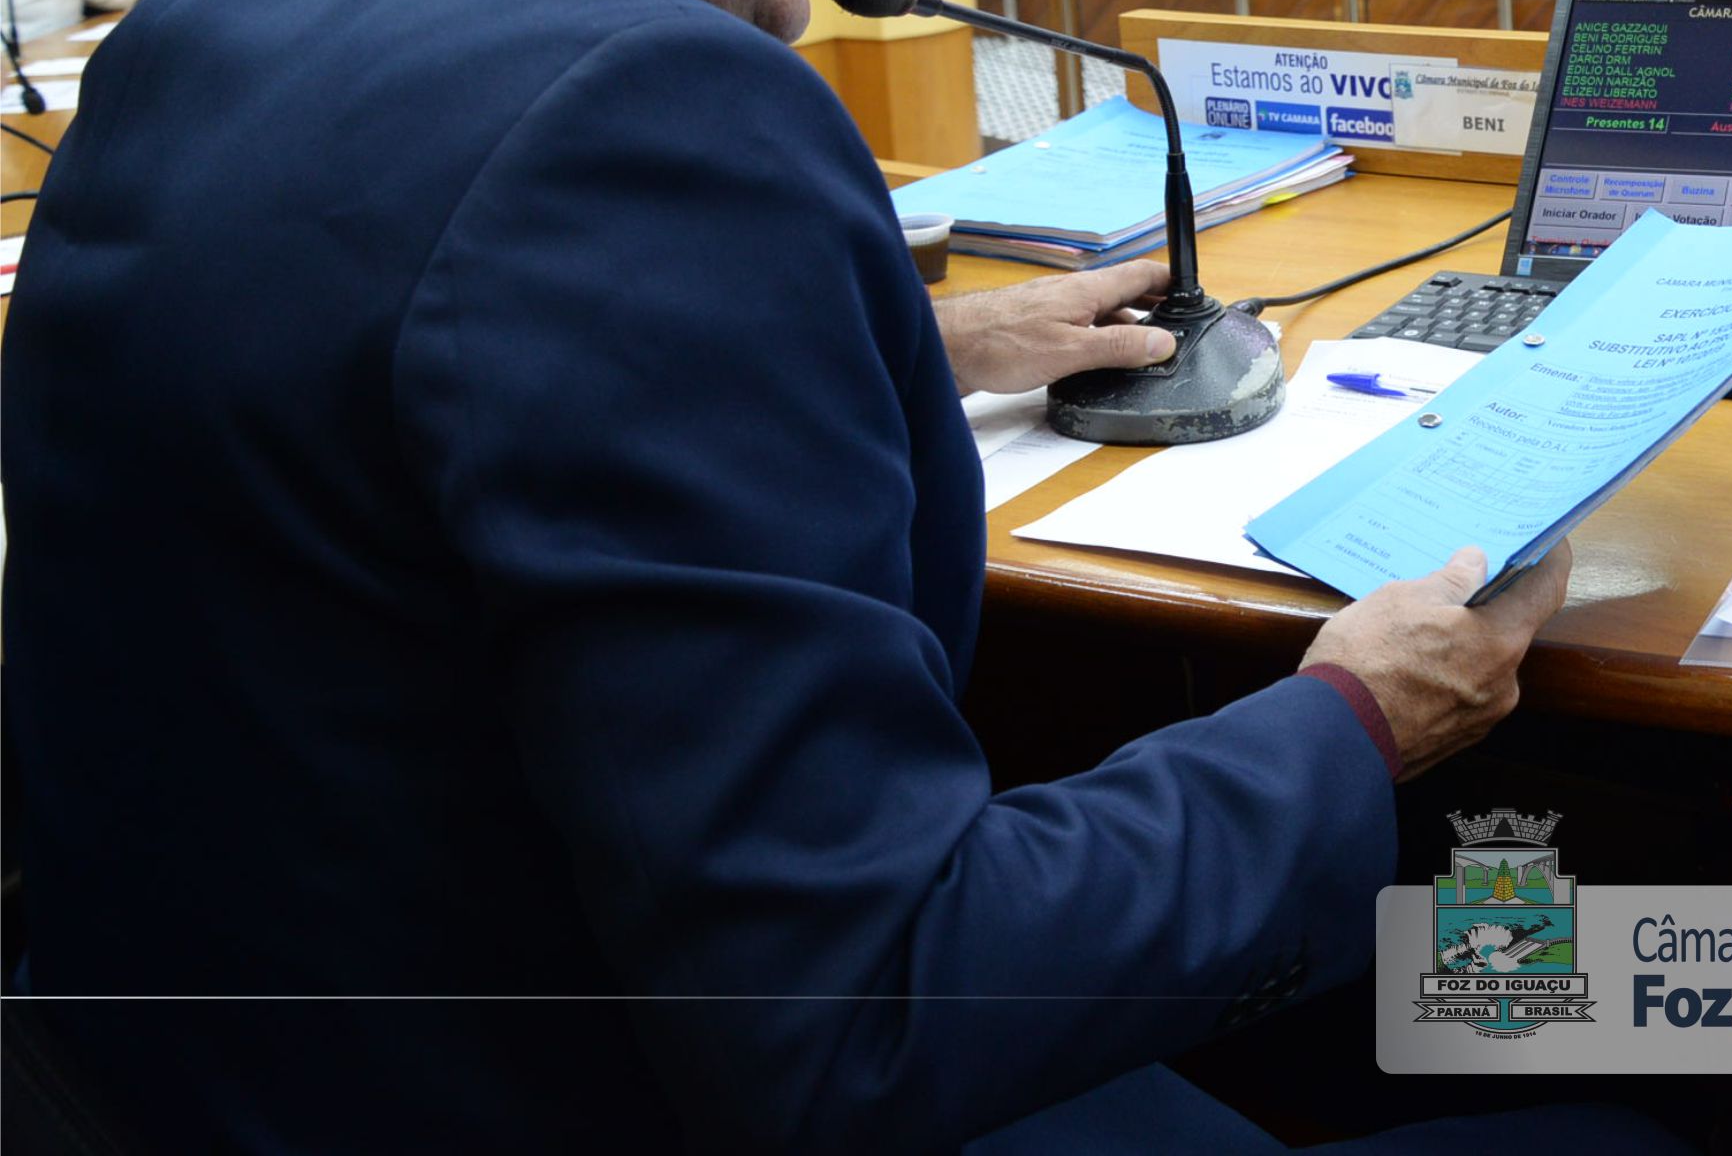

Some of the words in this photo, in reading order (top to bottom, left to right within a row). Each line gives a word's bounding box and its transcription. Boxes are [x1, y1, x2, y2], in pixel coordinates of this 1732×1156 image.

[1576, 22, 1608, 32] ANICE
[1611, 23, 1668, 33] GAZZAOUI
[1574, 33, 1599, 43] BENI
[1602, 34, 1668, 44] RODRIGUES
[1571, 44, 1611, 54] CELINO
[1614, 45, 1663, 55] FERTRIN
[1275, 52, 1328, 70] ATENÇÃO
[1569, 55, 1603, 64] DARCI
[1606, 55, 1631, 65] DRM
[1567, 65, 1602, 75] EDILIO
[1211, 63, 1293, 93] Estamos
[1300, 74, 1323, 95] ao
[1447, 75, 1489, 89] Municipal
[1489, 77, 1501, 88] de
[1565, 76, 1603, 86] EDSON
[1606, 75, 1655, 87] NARIZÃO
[1562, 86, 1600, 97] ELIZEU
[1604, 87, 1657, 99] LIBERATO
[1207, 98, 1248, 113] PLENÁRIO
[1208, 111, 1250, 129] ONLINE
[1268, 112, 1280, 121] TV
[1586, 116, 1645, 130] Presentes
[1649, 117, 1665, 131] 14
[1330, 113, 1393, 136] faceboo
[1462, 116, 1505, 133] BENI
[1682, 185, 1715, 197] Buzina
[1542, 207, 1576, 220] Iniciar
[1579, 210, 1617, 222] Orador
[1672, 214, 1718, 227] Votação
[1653, 333, 1688, 344] SAPL
[1588, 340, 1689, 357] SUBSTITUTIVO
[1633, 358, 1656, 369] LEI
[1530, 363, 1583, 383] Ementa:
[1485, 401, 1528, 422] Autor:
[1469, 415, 1518, 440] Recebido
[1518, 433, 1542, 450] pela
